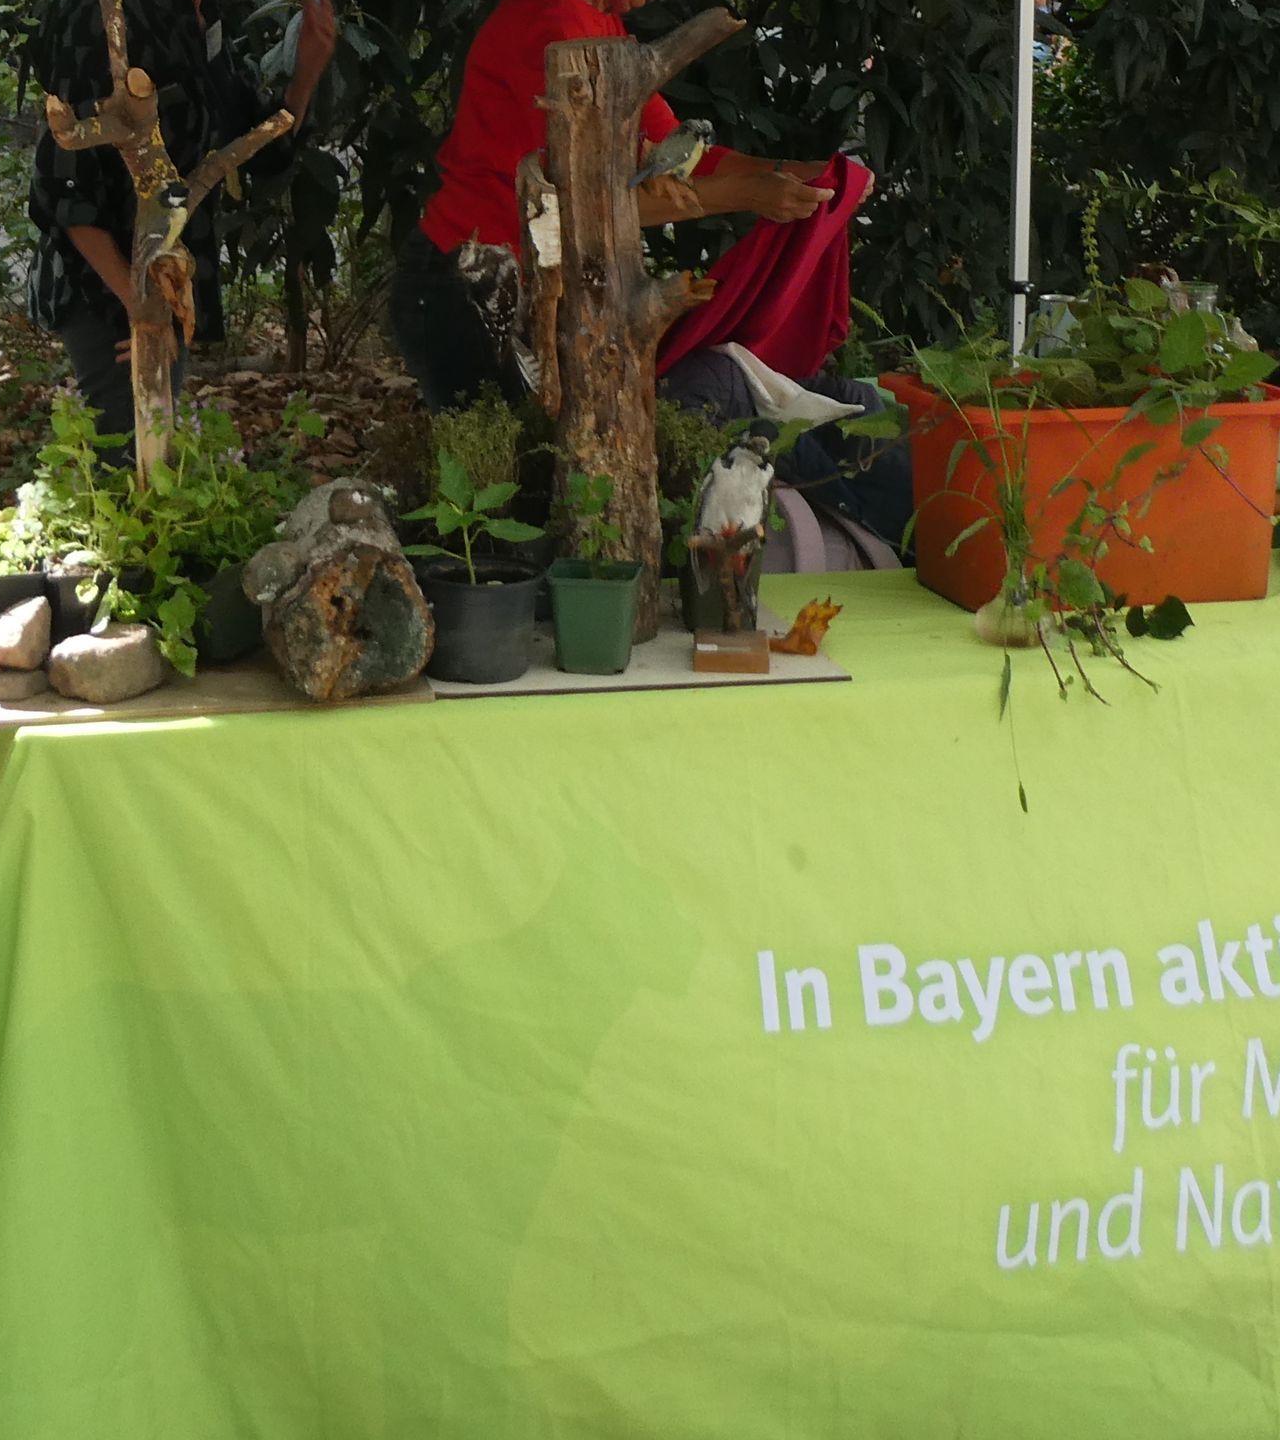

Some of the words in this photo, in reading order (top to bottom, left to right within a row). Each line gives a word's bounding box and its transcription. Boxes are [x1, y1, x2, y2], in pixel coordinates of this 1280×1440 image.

[757, 949, 833, 1033] In
[857, 943, 1134, 1043] Bayern
[1111, 1043, 1216, 1153] für
[995, 1166, 1144, 1270] und
